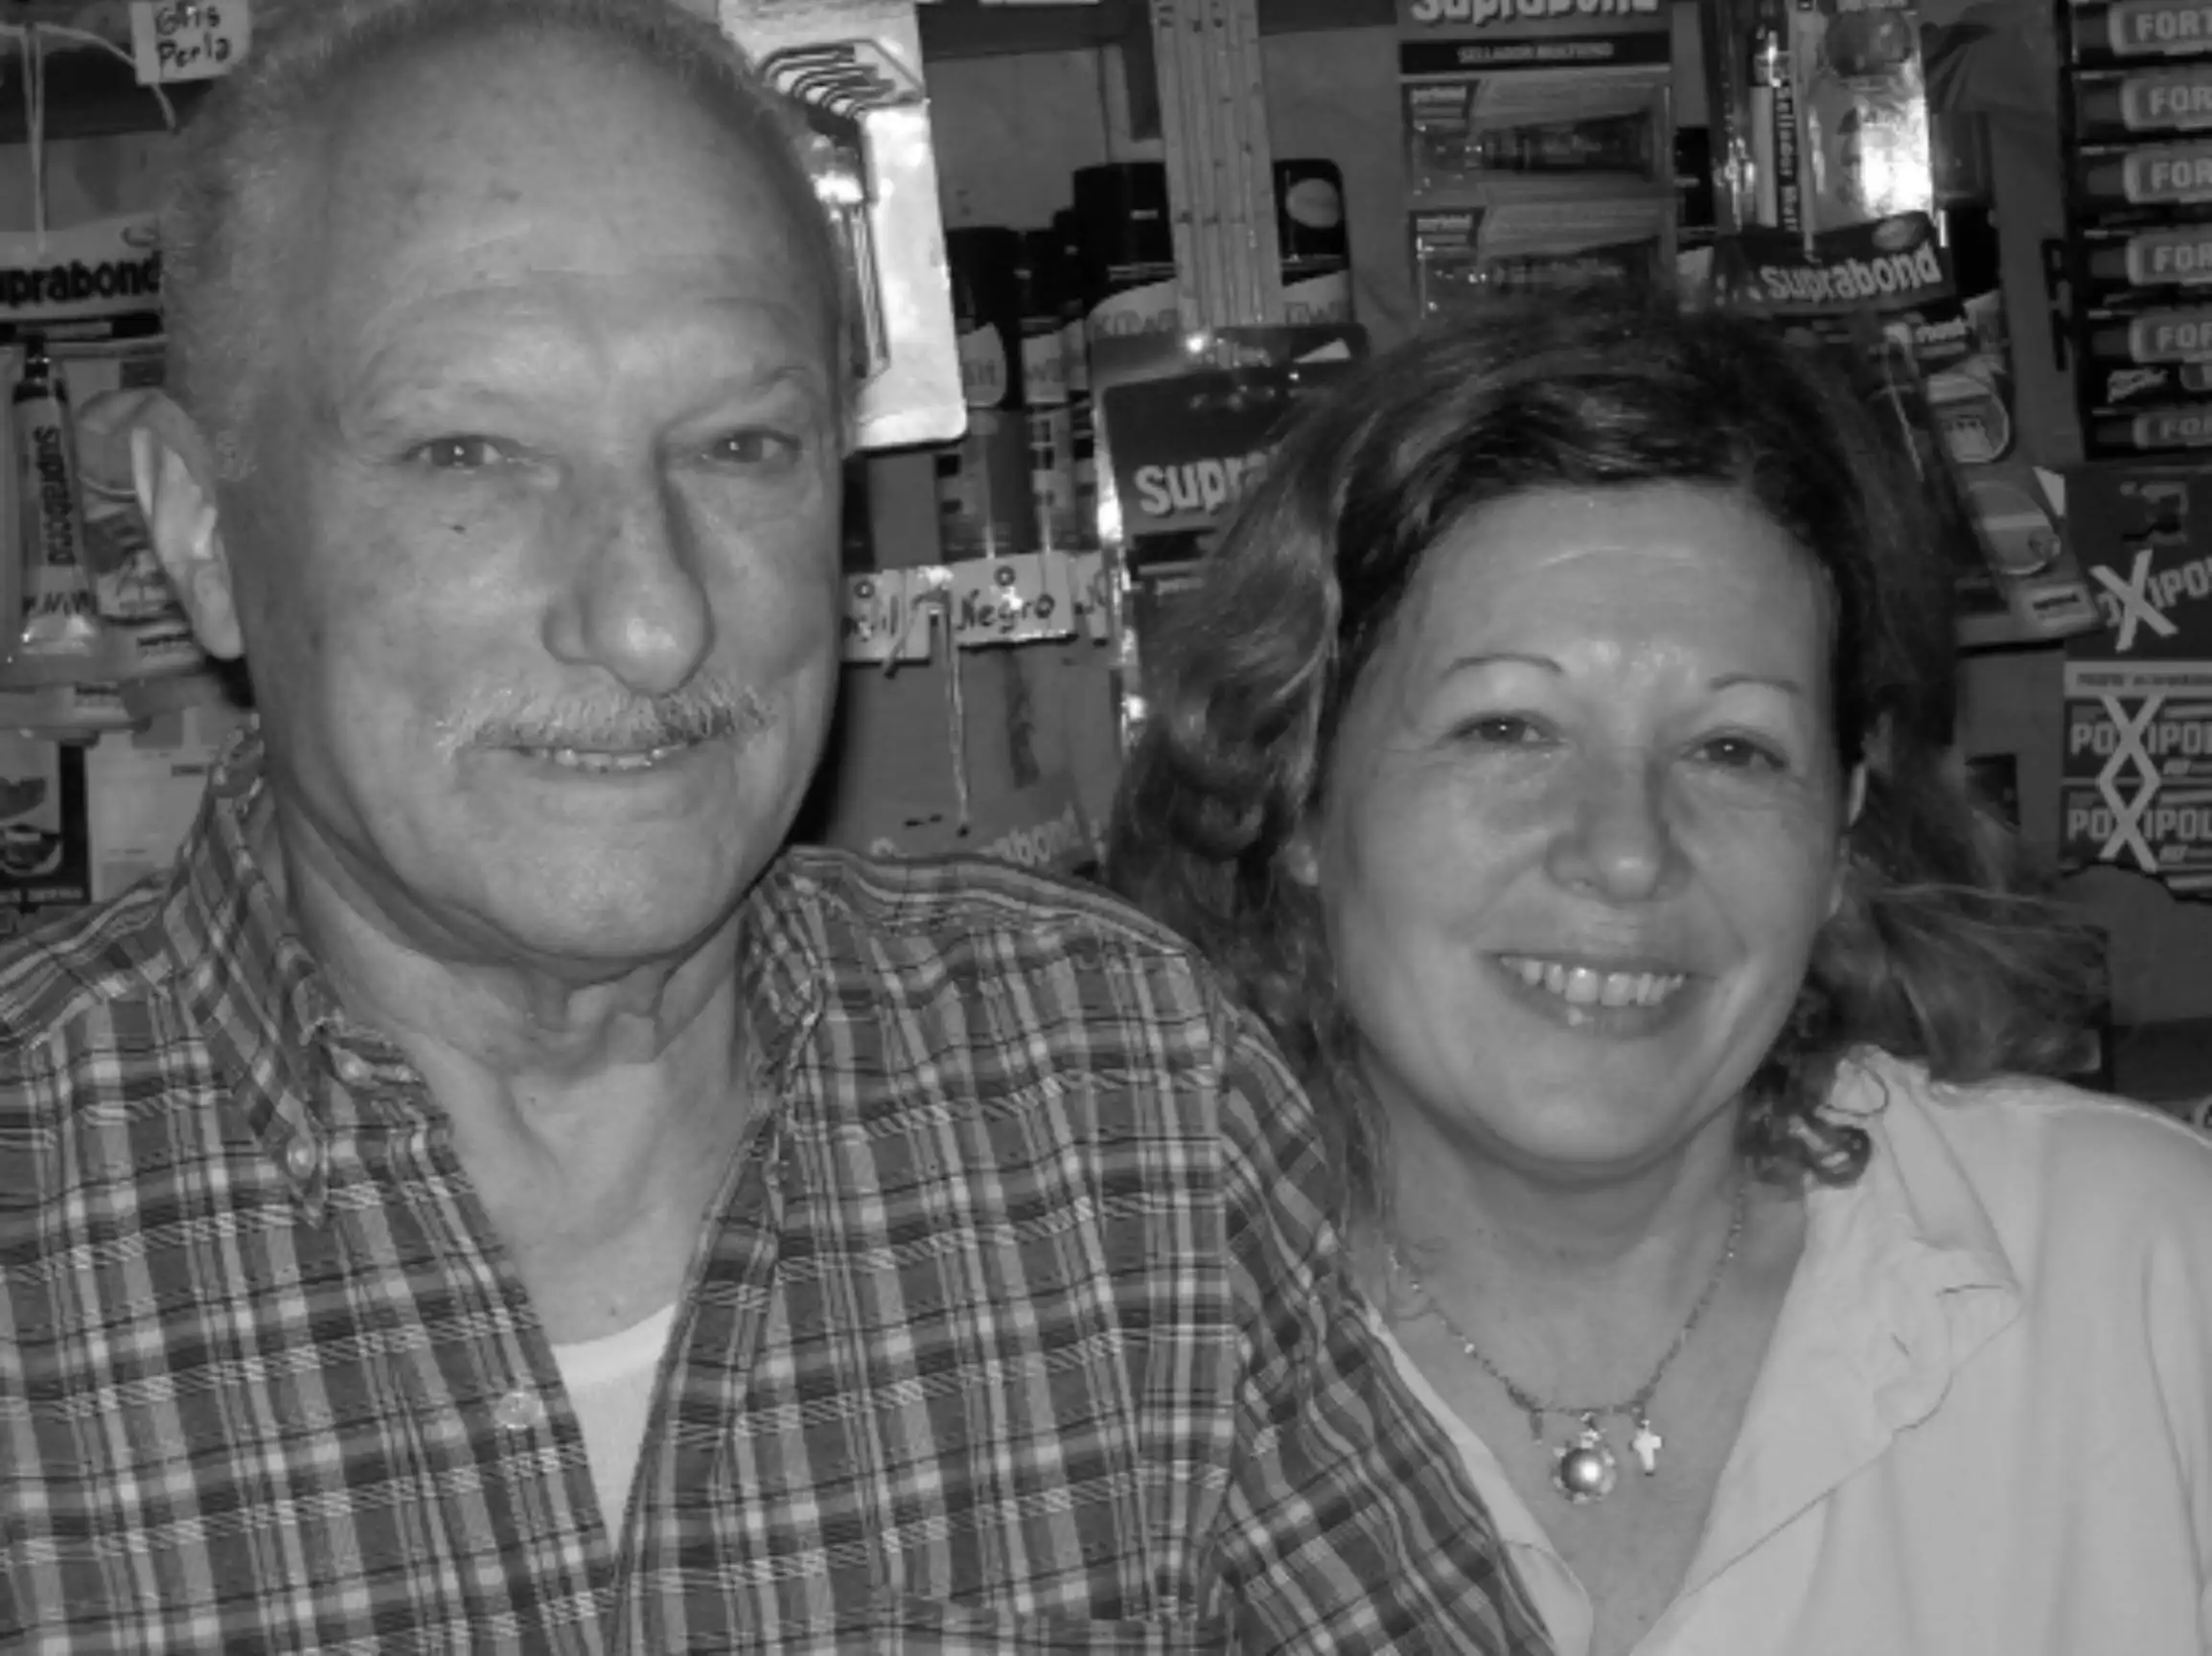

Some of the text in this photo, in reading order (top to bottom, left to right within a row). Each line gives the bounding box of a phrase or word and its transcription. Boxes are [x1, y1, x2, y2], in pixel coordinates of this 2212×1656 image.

[0, 250, 161, 309] prabond
[1761, 241, 1942, 301] Suprabond
[956, 588, 1055, 633] Negro
